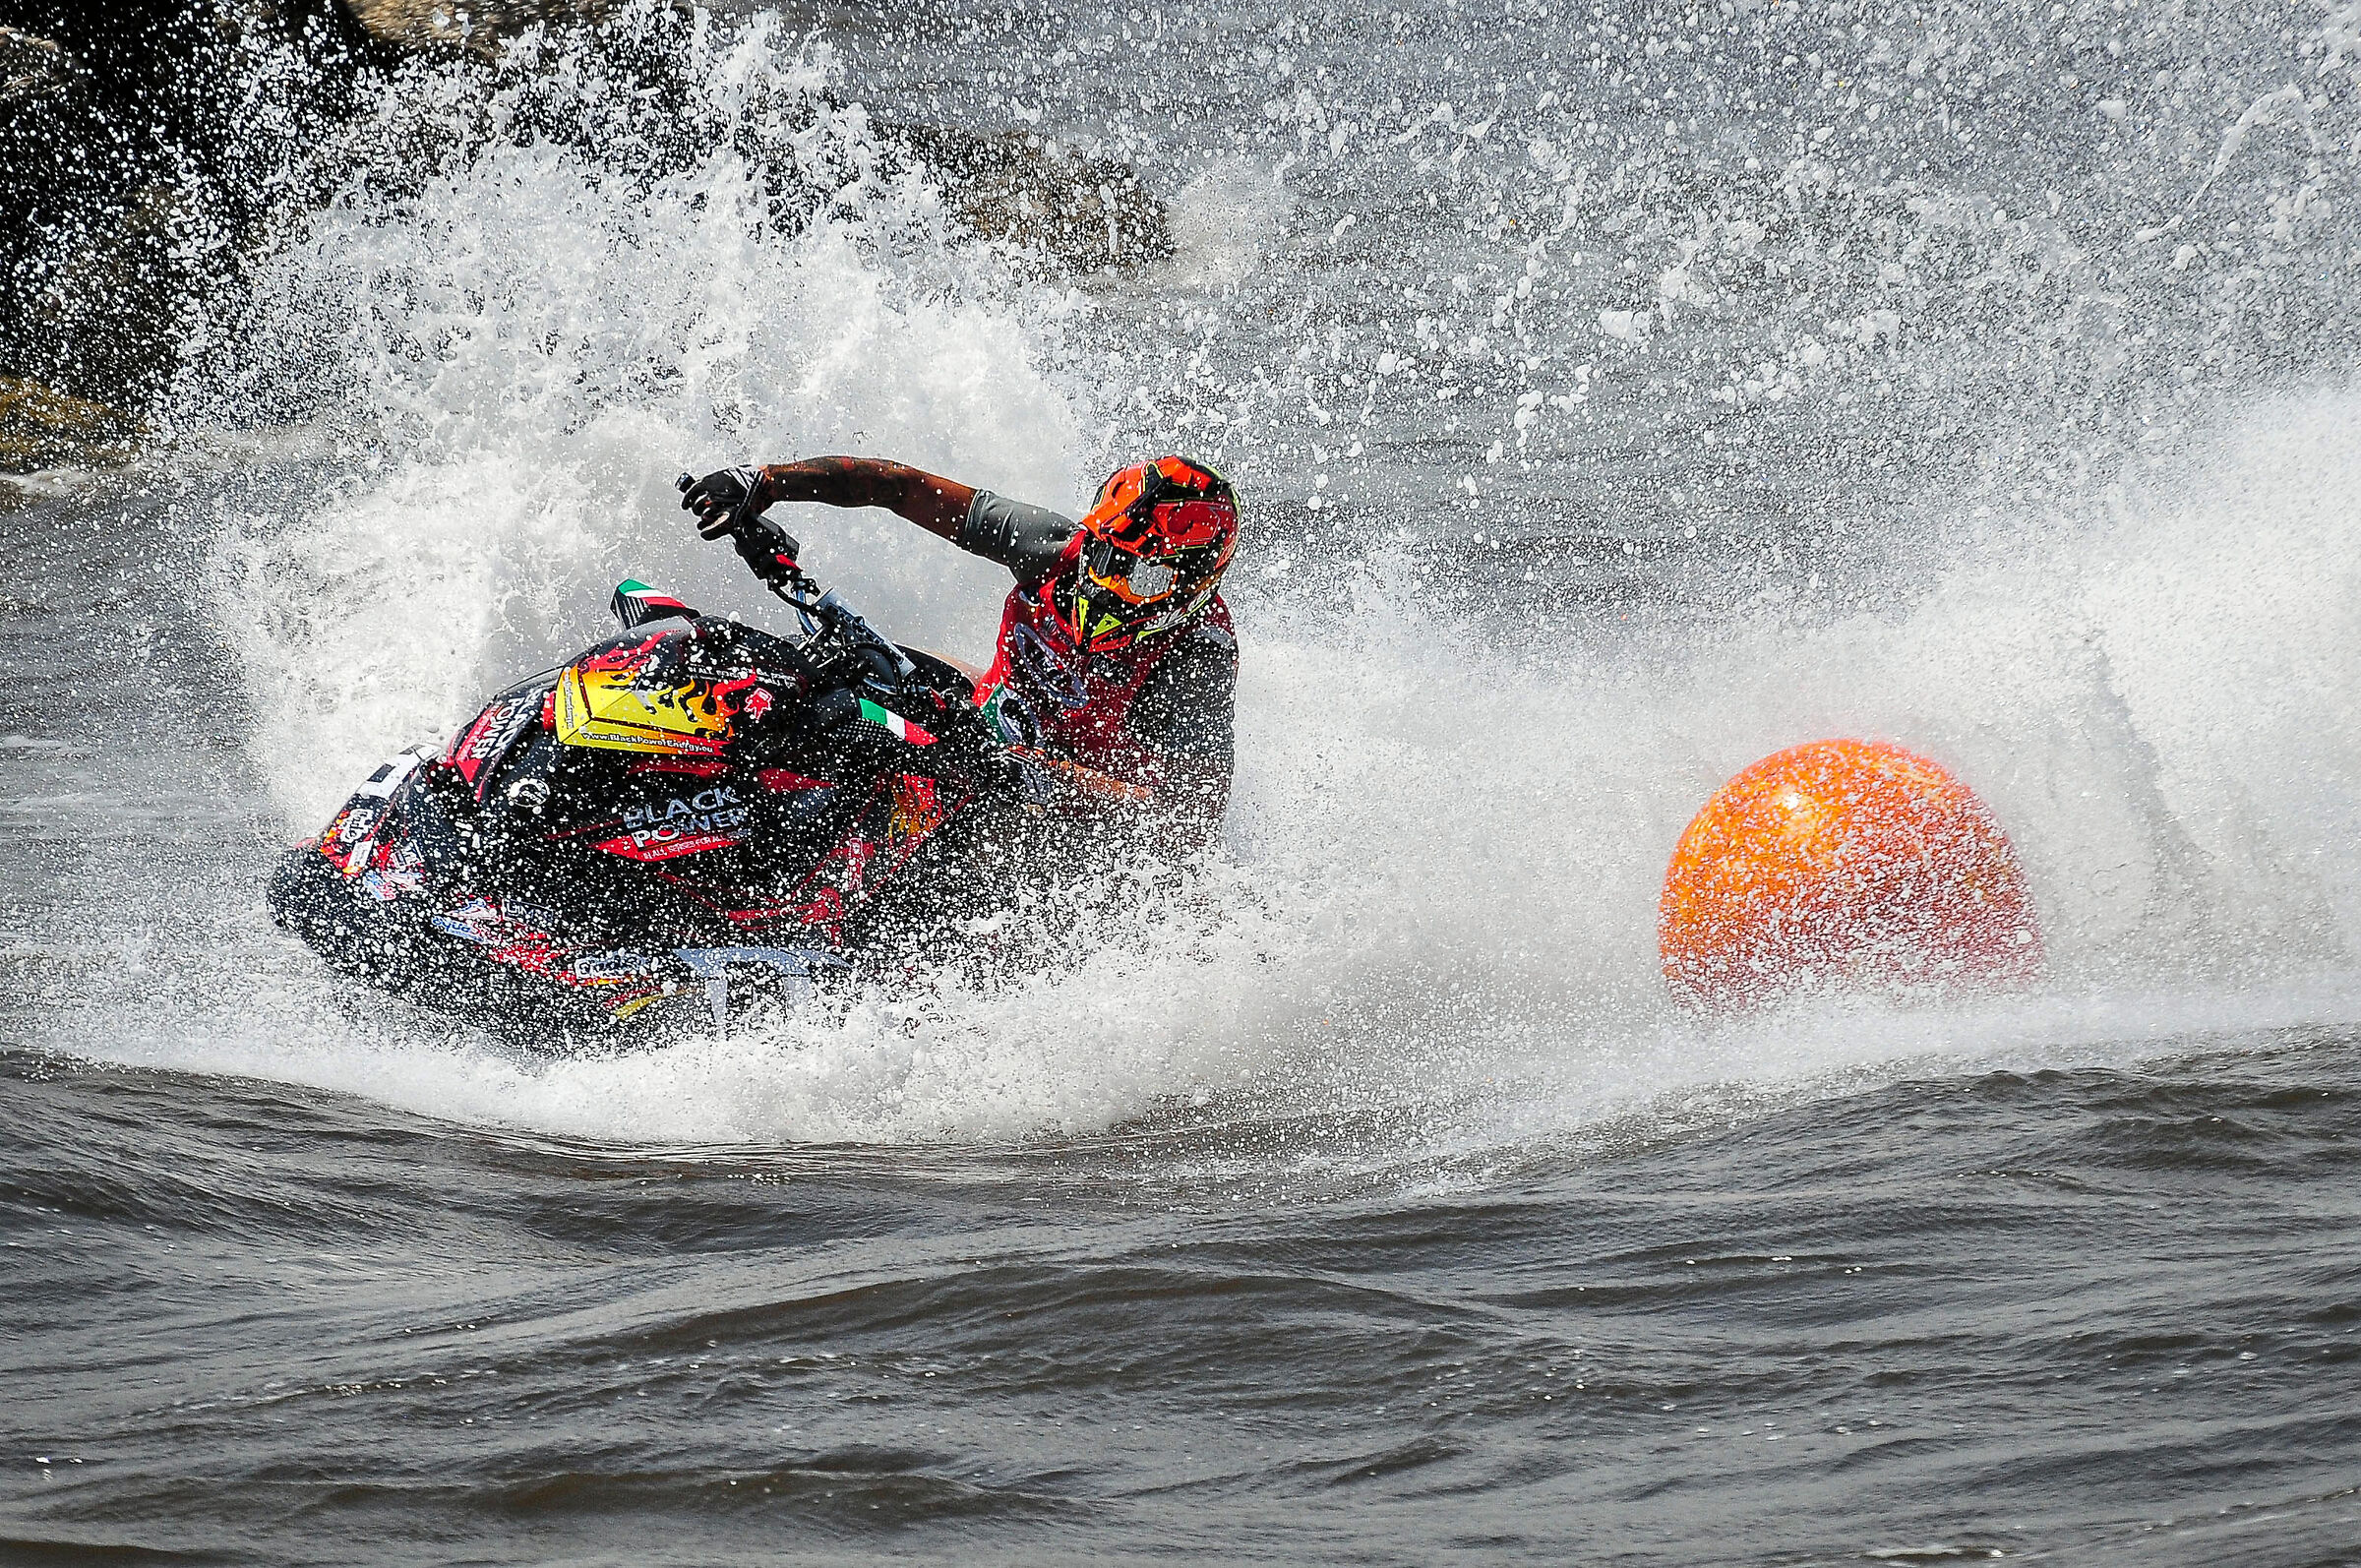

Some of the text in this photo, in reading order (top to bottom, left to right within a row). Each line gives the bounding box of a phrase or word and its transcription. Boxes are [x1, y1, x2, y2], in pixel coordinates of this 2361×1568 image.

[470, 697, 524, 758] POWER
[489, 688, 542, 757] BLACK
[624, 786, 741, 829] BLACK
[632, 808, 748, 847] POWER
